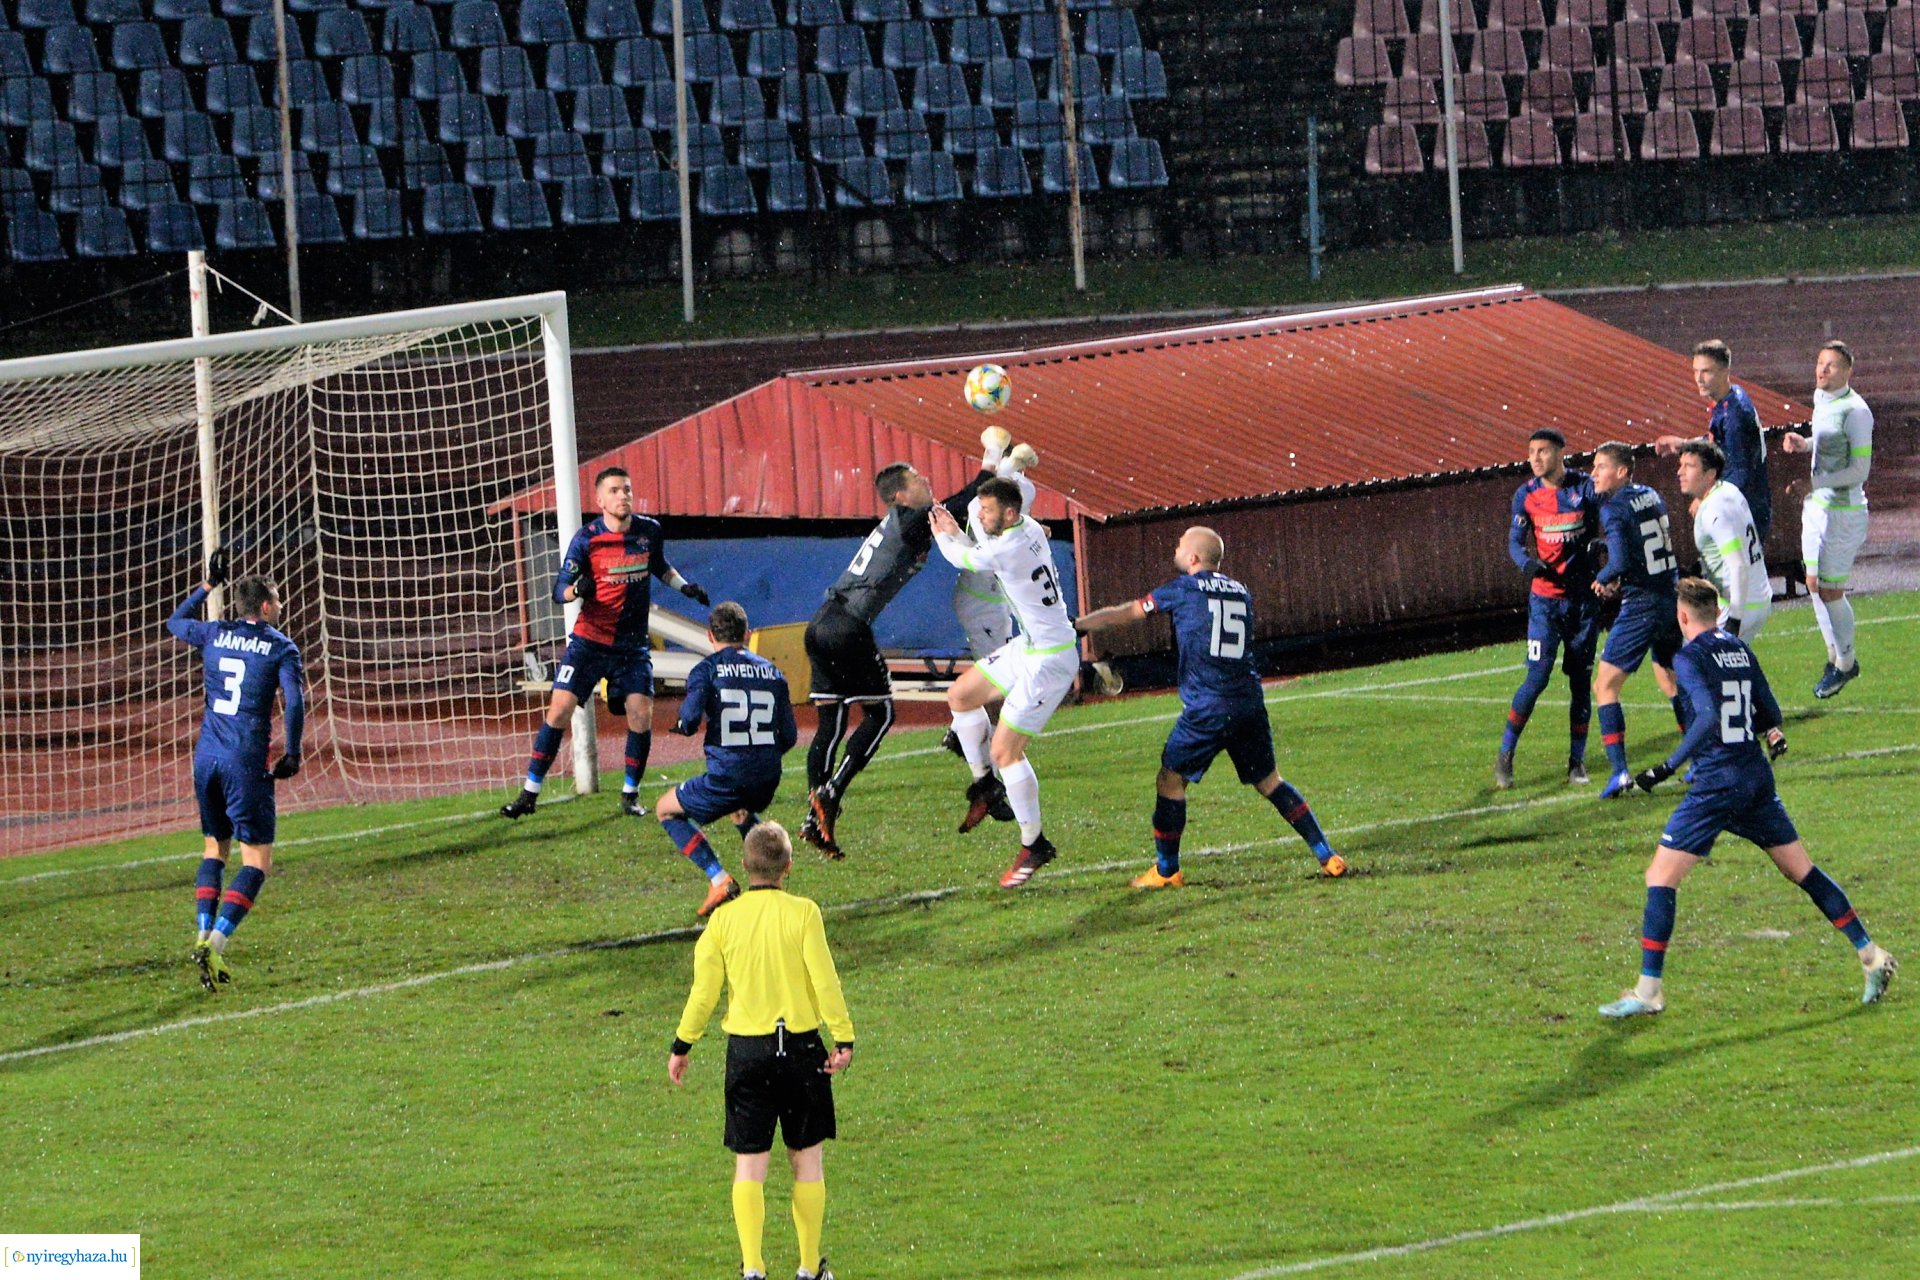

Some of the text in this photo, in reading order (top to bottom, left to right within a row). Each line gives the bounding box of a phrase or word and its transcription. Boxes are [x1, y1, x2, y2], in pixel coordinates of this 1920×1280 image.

[213, 630, 272, 656] JÁNVÁRI
[1207, 598, 1247, 659] 15
[213, 657, 246, 716] 3
[557, 664, 575, 684] 10
[720, 688, 776, 747] 22
[1721, 680, 1754, 744] 21
